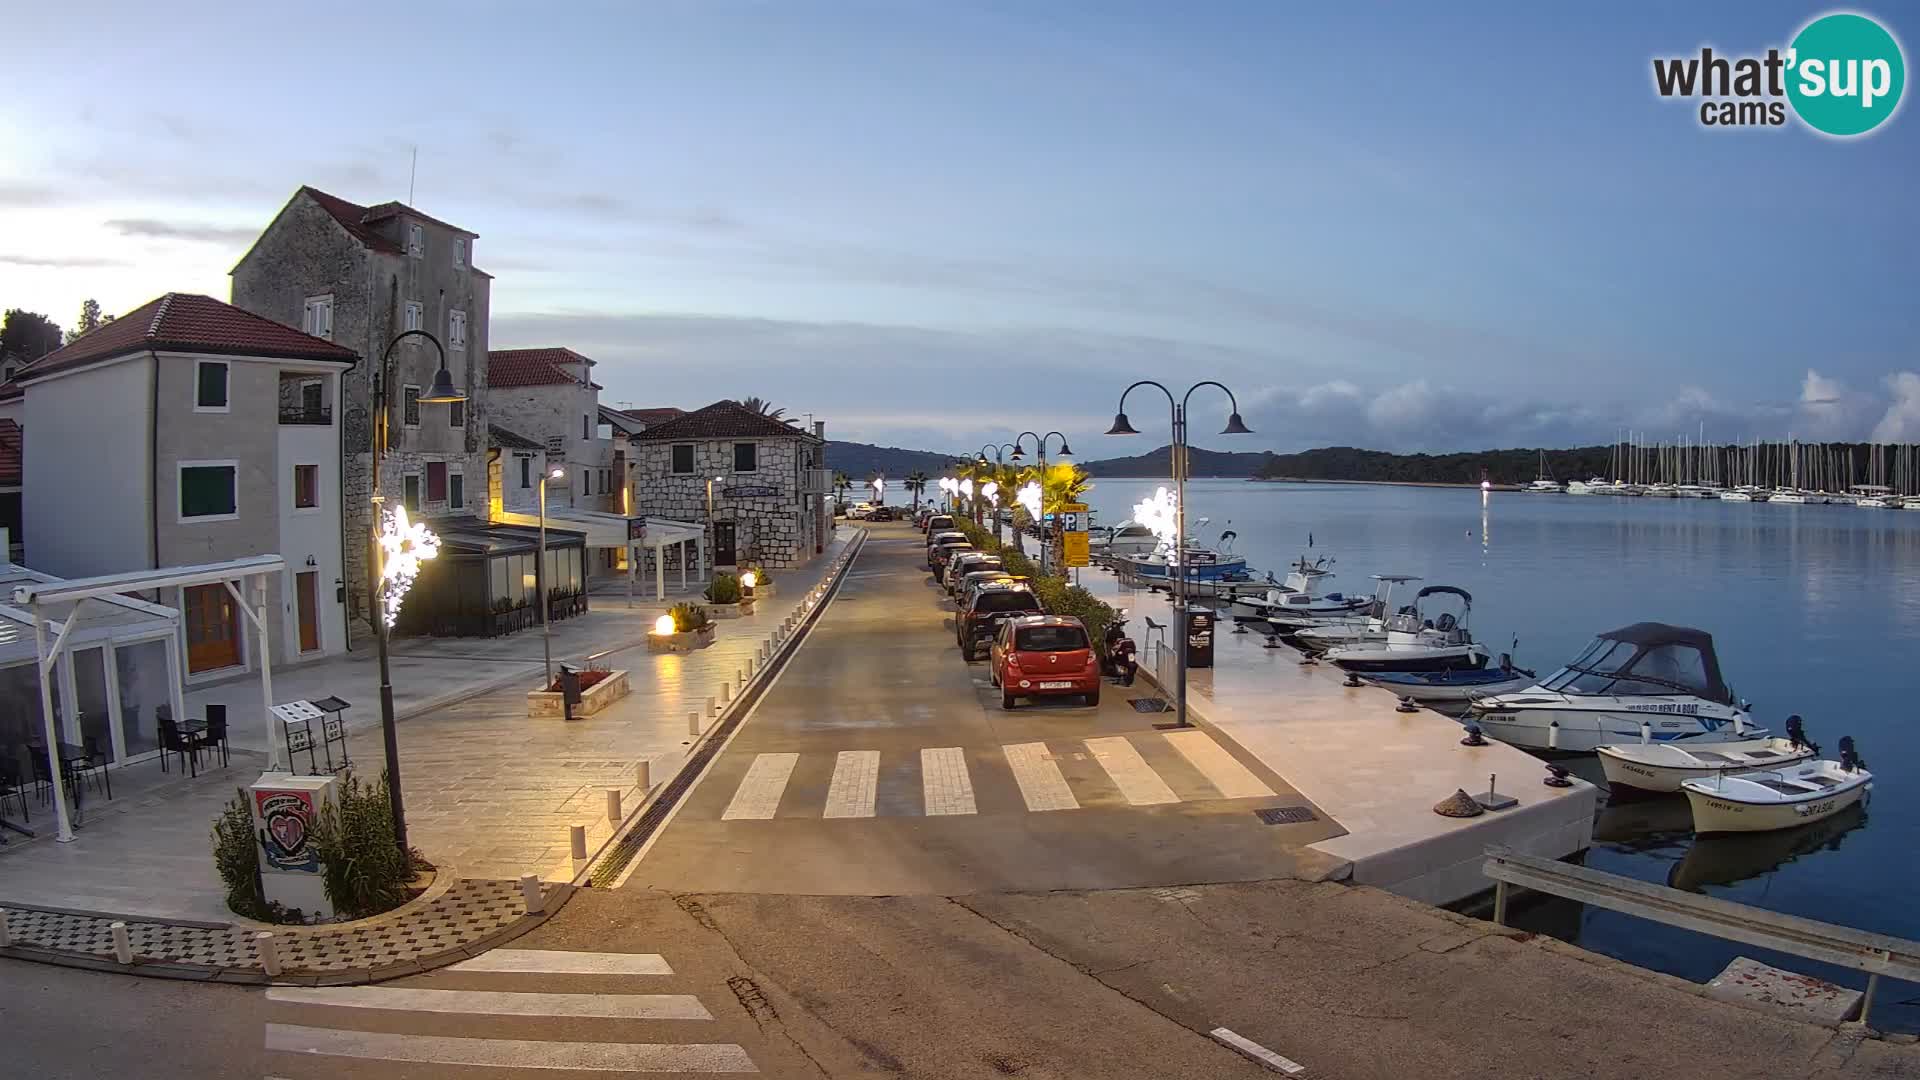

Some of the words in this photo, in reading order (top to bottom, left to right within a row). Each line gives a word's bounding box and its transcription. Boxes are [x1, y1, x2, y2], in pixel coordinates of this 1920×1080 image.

[1066, 514, 1075, 530] P
[1658, 704, 1676, 713] RENT
[1682, 704, 1699, 714] BOAT
